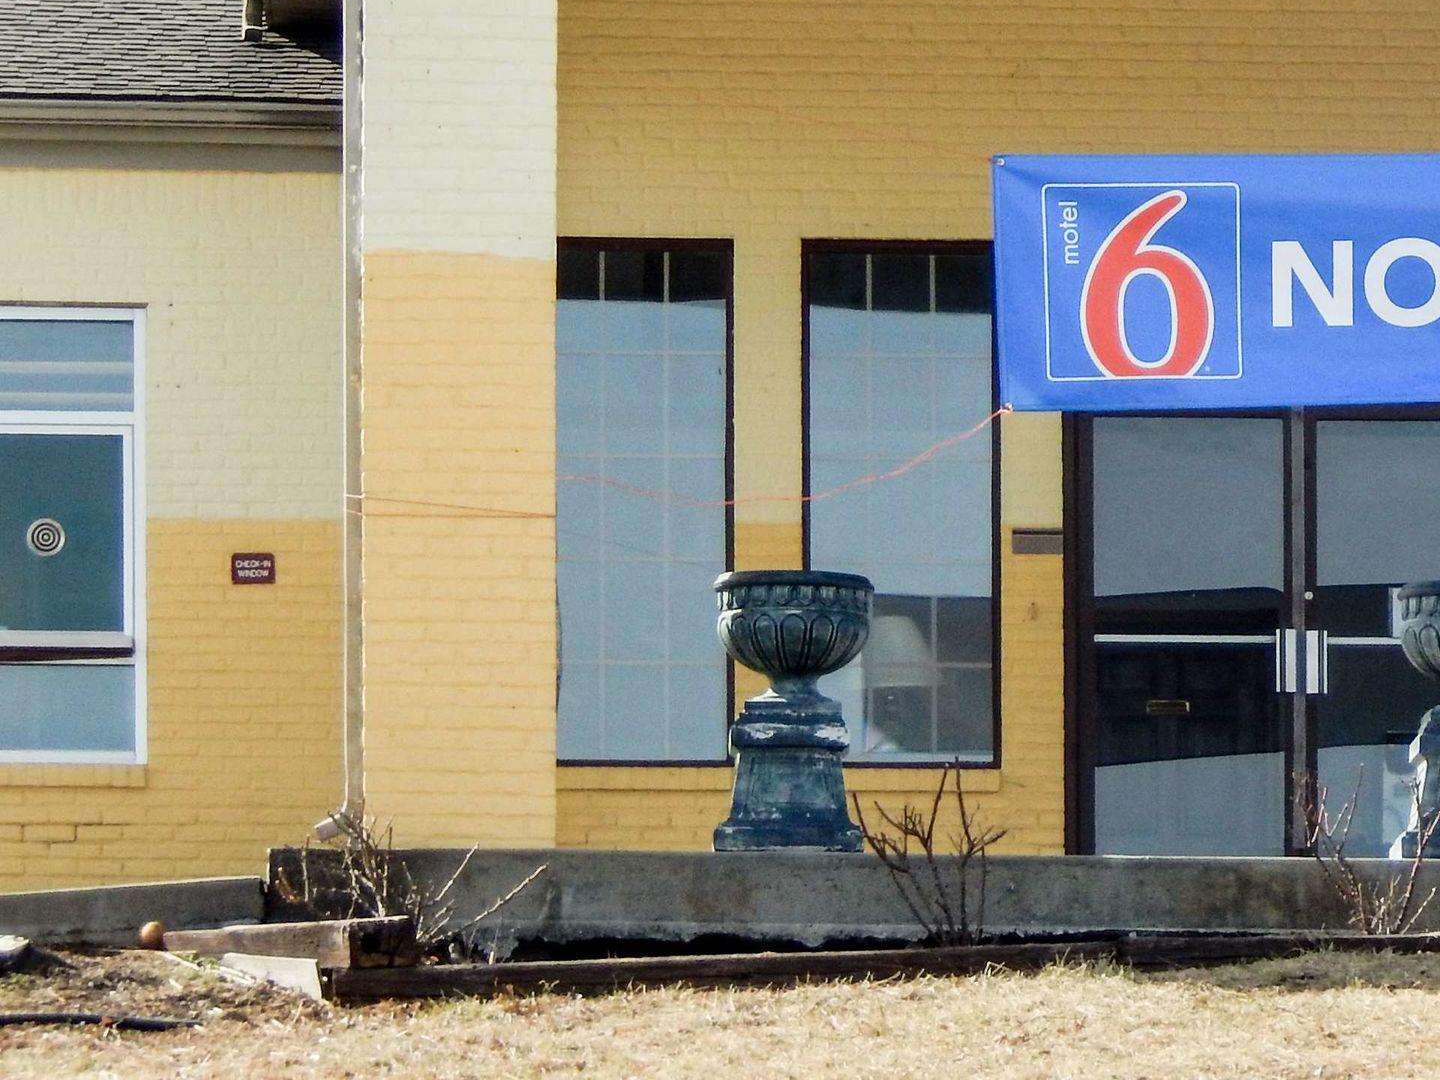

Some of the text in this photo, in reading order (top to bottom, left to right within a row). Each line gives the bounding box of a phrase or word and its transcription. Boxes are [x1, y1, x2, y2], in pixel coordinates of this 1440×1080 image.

[1058, 200, 1080, 265] motel
[1079, 189, 1215, 378] 6
[235, 560, 271, 568] CHECK-IN
[237, 569, 270, 577] WINDOW
